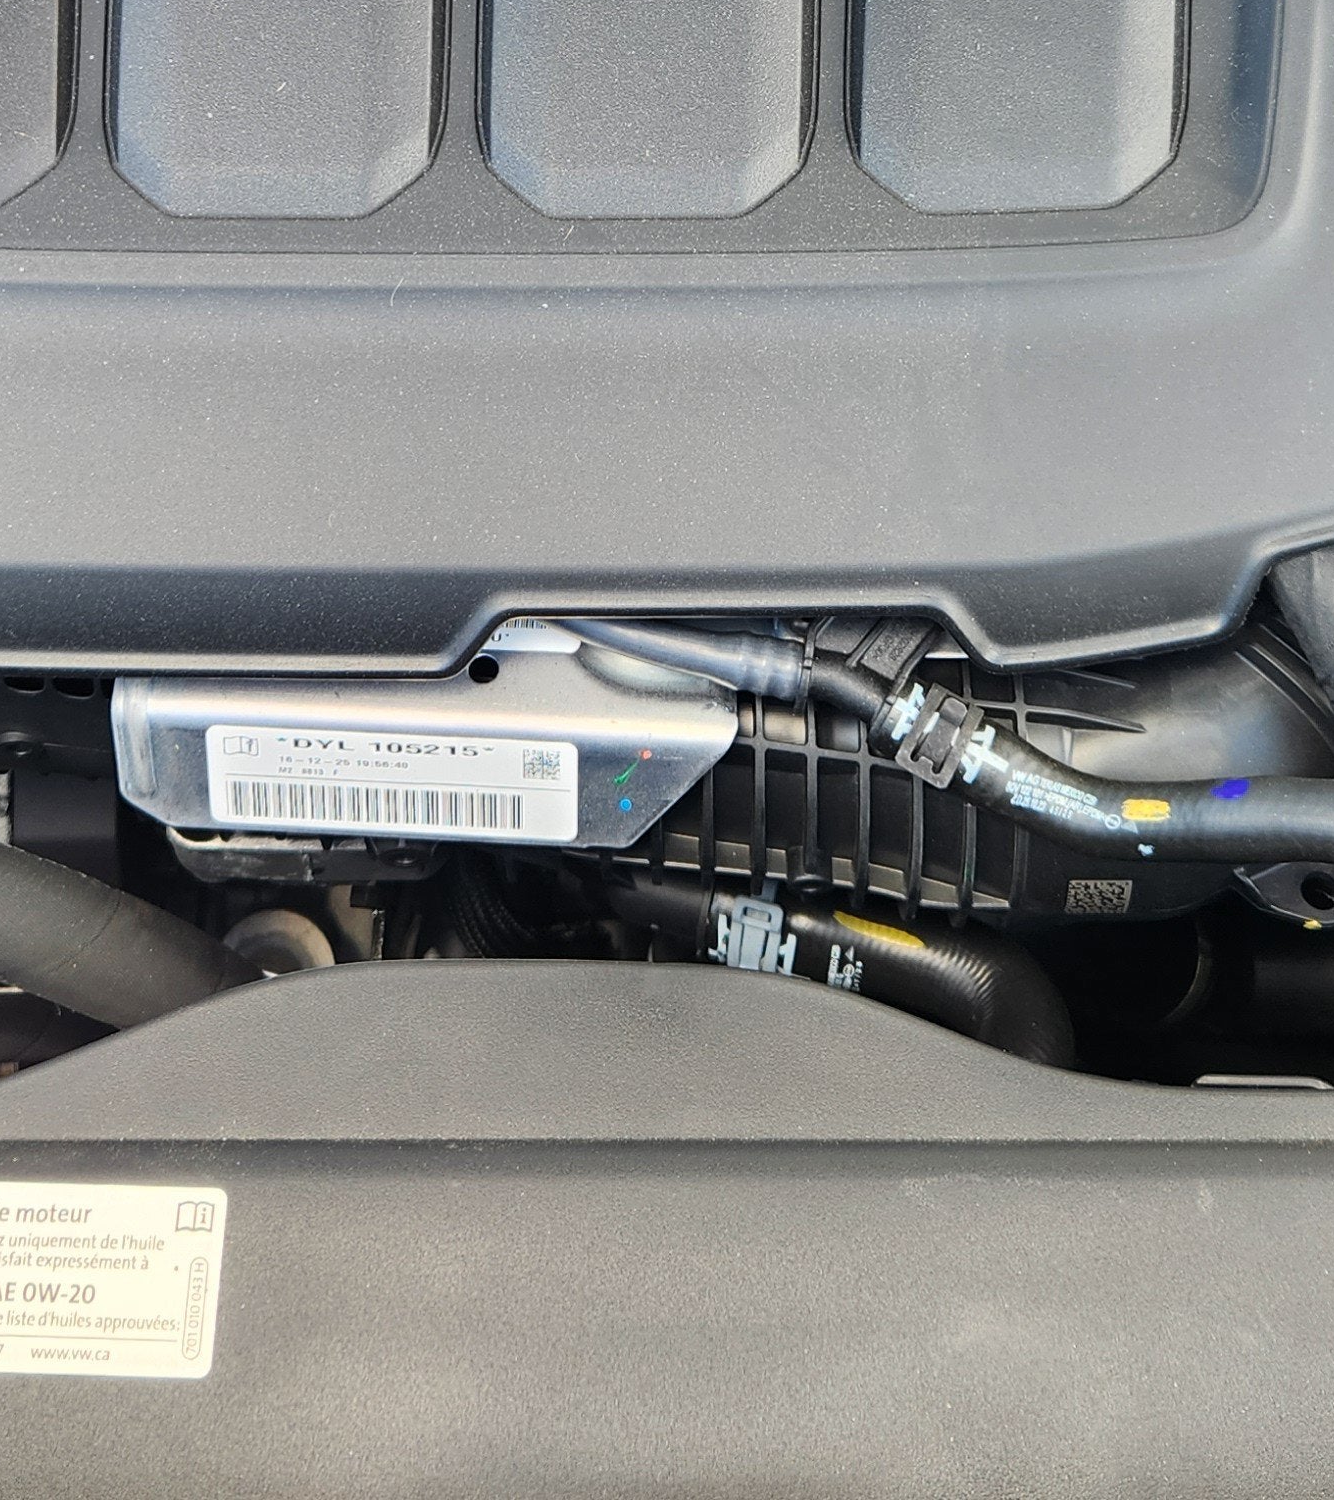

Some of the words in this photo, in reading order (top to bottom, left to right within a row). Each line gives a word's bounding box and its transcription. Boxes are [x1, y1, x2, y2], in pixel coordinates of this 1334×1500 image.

[15, 1204, 92, 1223] moteur
[8, 1232, 96, 1250] uniquement
[99, 1233, 118, 1249] de
[121, 1234, 164, 1251] l'huile
[35, 1253, 136, 1269] expressément
[140, 1255, 148, 1269] à
[22, 1282, 95, 1304] 0W-20
[6, 1310, 35, 1326] liste
[37, 1311, 91, 1327] d'huiles
[30, 1348, 110, 1360] www.vw.ca
